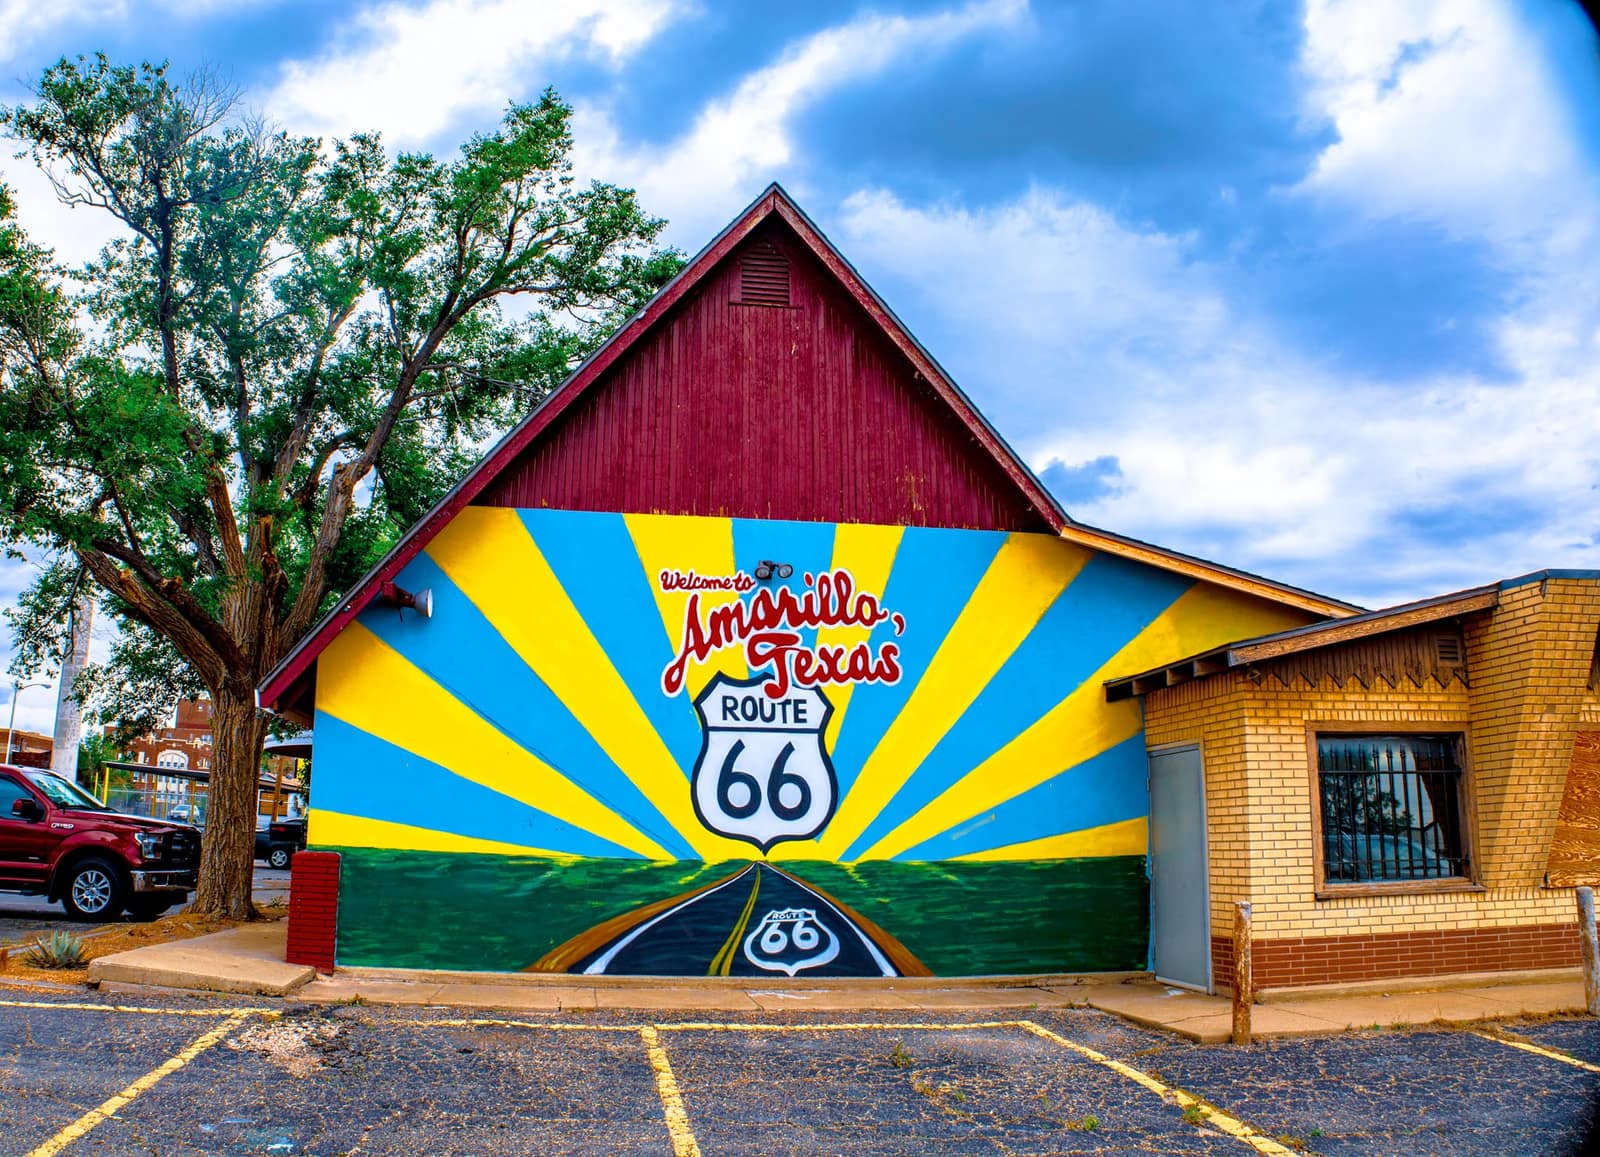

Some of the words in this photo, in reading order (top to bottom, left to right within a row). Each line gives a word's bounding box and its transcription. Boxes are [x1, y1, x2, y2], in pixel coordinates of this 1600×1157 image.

[660, 571, 733, 590] Welcome
[733, 572, 755, 591] to
[664, 571, 905, 693] Amarillo,
[748, 633, 900, 699] Texas
[722, 695, 807, 724] ROUTE
[717, 739, 811, 821] 66
[771, 911, 805, 920] ROUTE
[761, 920, 819, 953] 66
